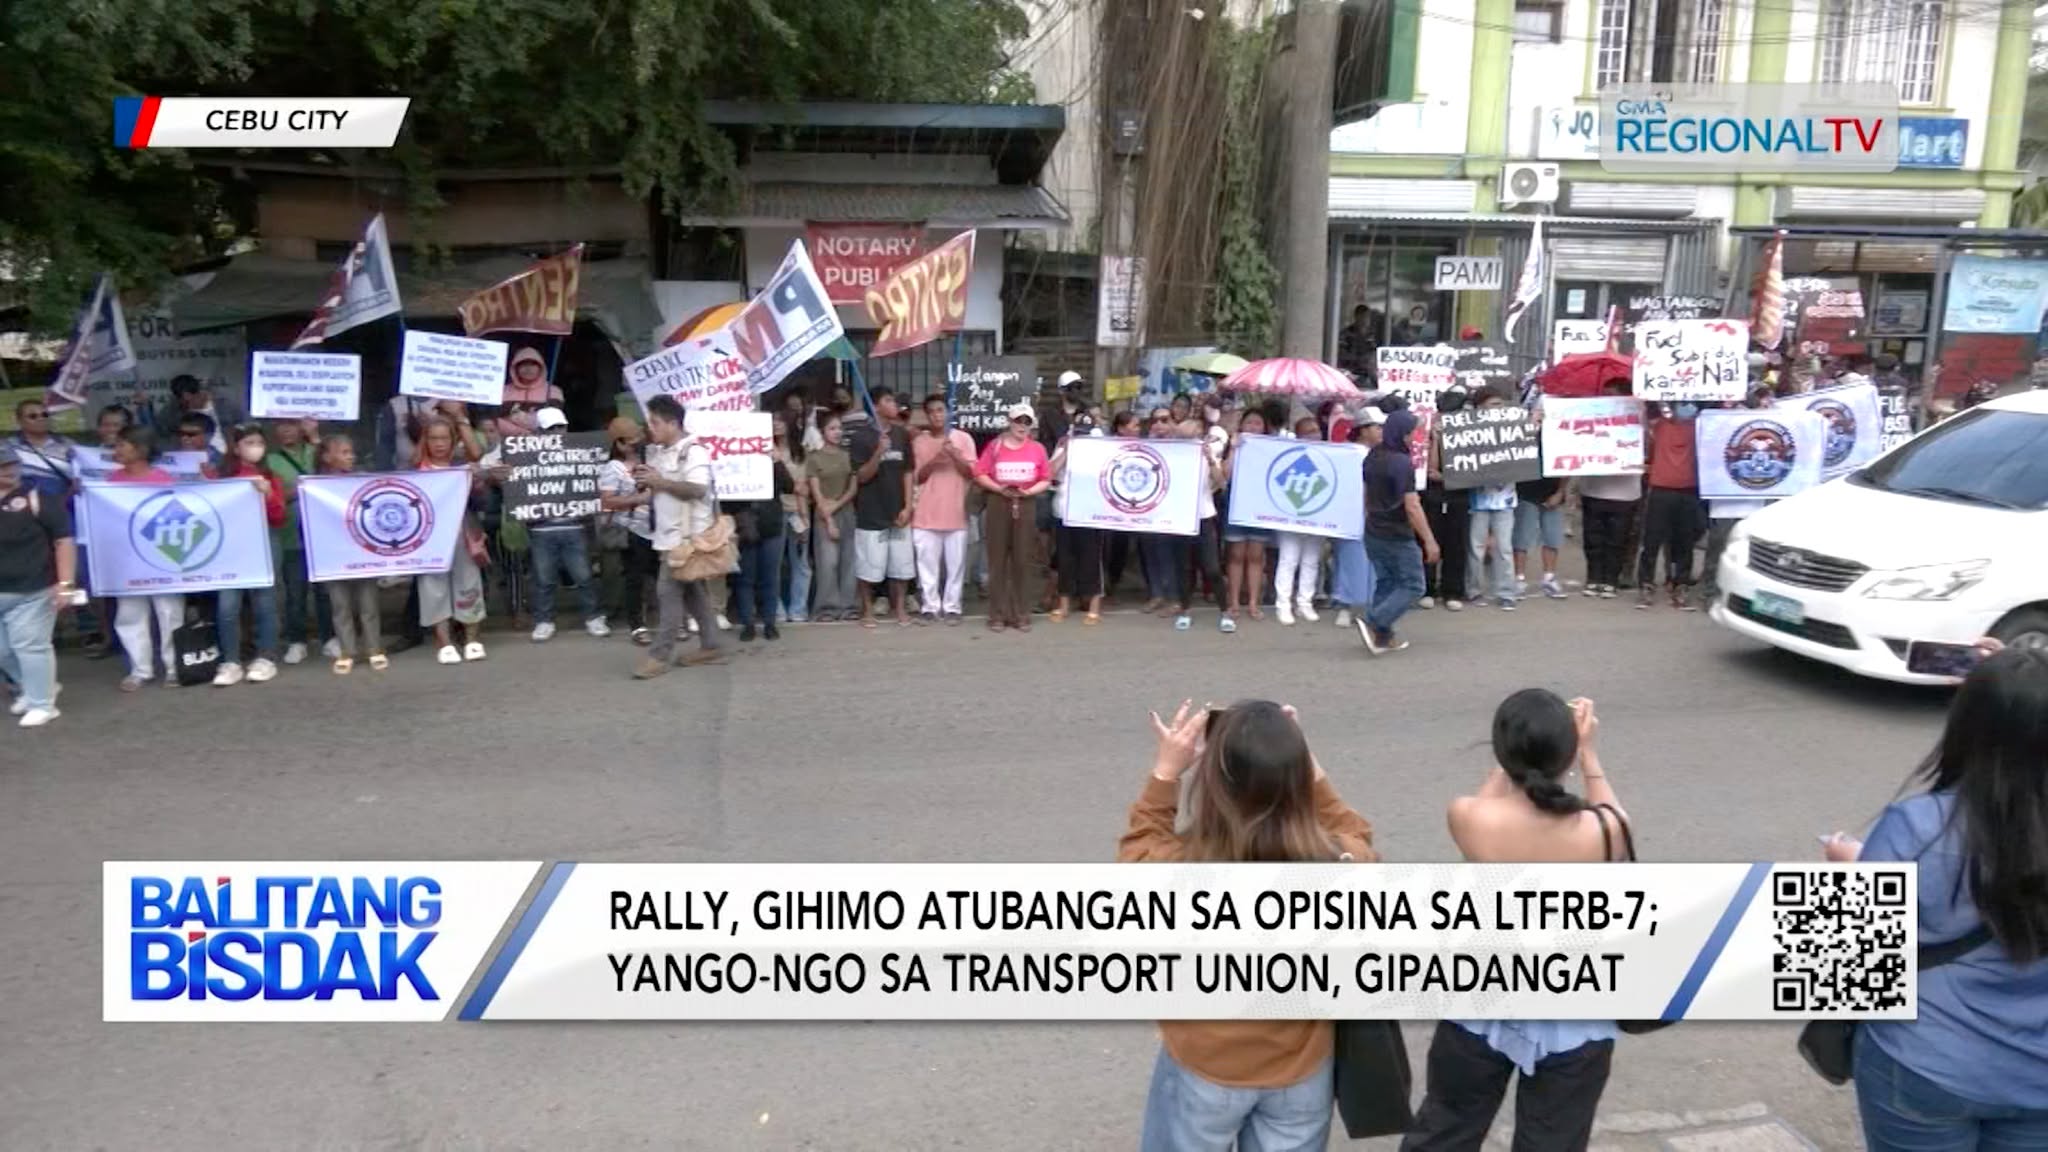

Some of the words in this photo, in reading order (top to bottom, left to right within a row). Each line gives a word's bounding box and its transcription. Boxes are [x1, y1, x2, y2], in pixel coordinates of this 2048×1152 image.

[1568, 110, 1592, 140] JQ
[817, 236, 916, 256] NOTARY
[1439, 263, 1500, 286] PAMI
[1442, 412, 1474, 428] FUEL
[505, 434, 563, 454] SERVICE
[1443, 427, 1497, 450] KARON
[527, 480, 567, 496] NOW
[572, 479, 595, 493] NA
